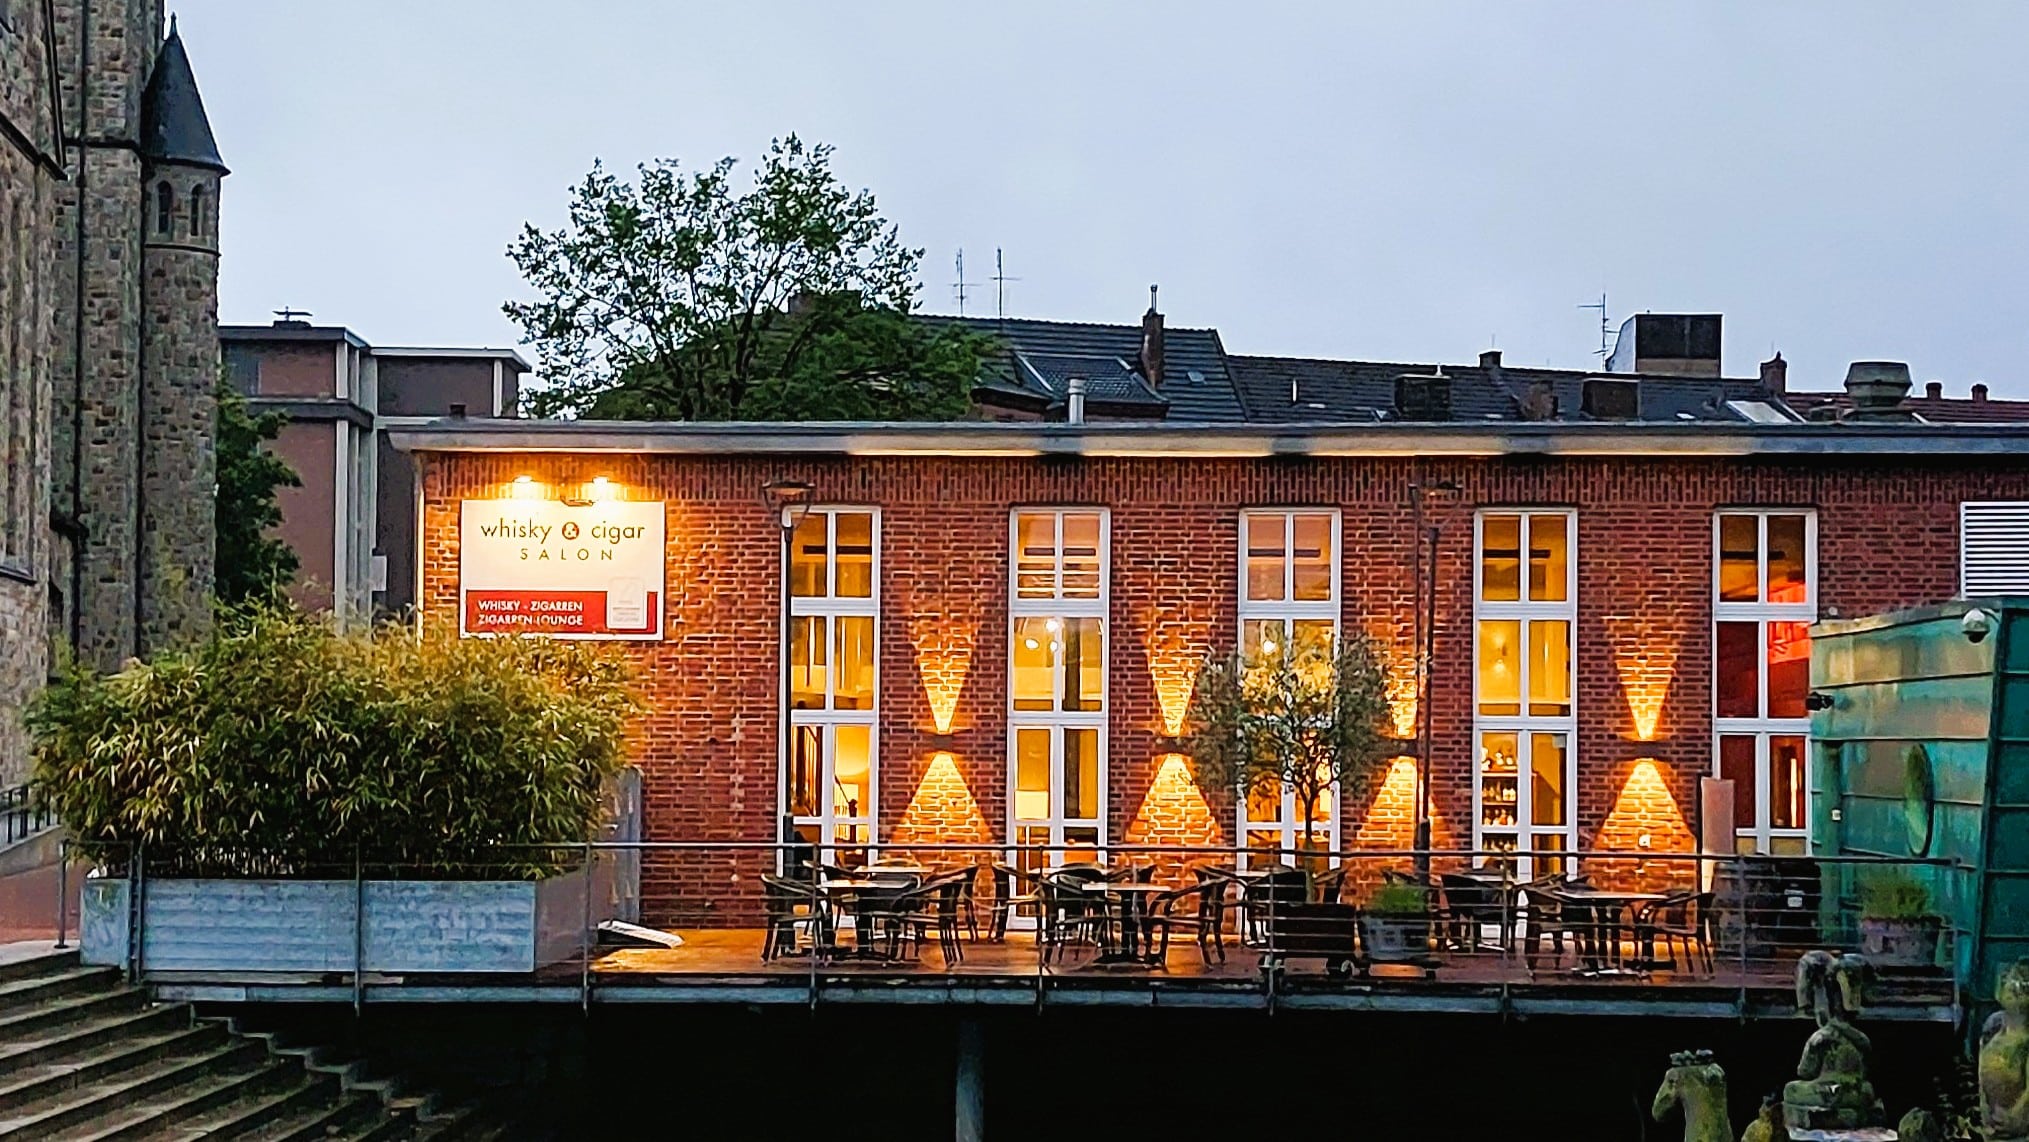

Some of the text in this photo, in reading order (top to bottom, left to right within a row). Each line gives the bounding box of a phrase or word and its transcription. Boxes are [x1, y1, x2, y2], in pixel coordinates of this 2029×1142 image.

[480, 517, 552, 544] whisky
[591, 520, 645, 544] cigar
[520, 548, 612, 561] SALON
[478, 600, 521, 611] WHISKY
[530, 600, 583, 612] ZIGARREN
